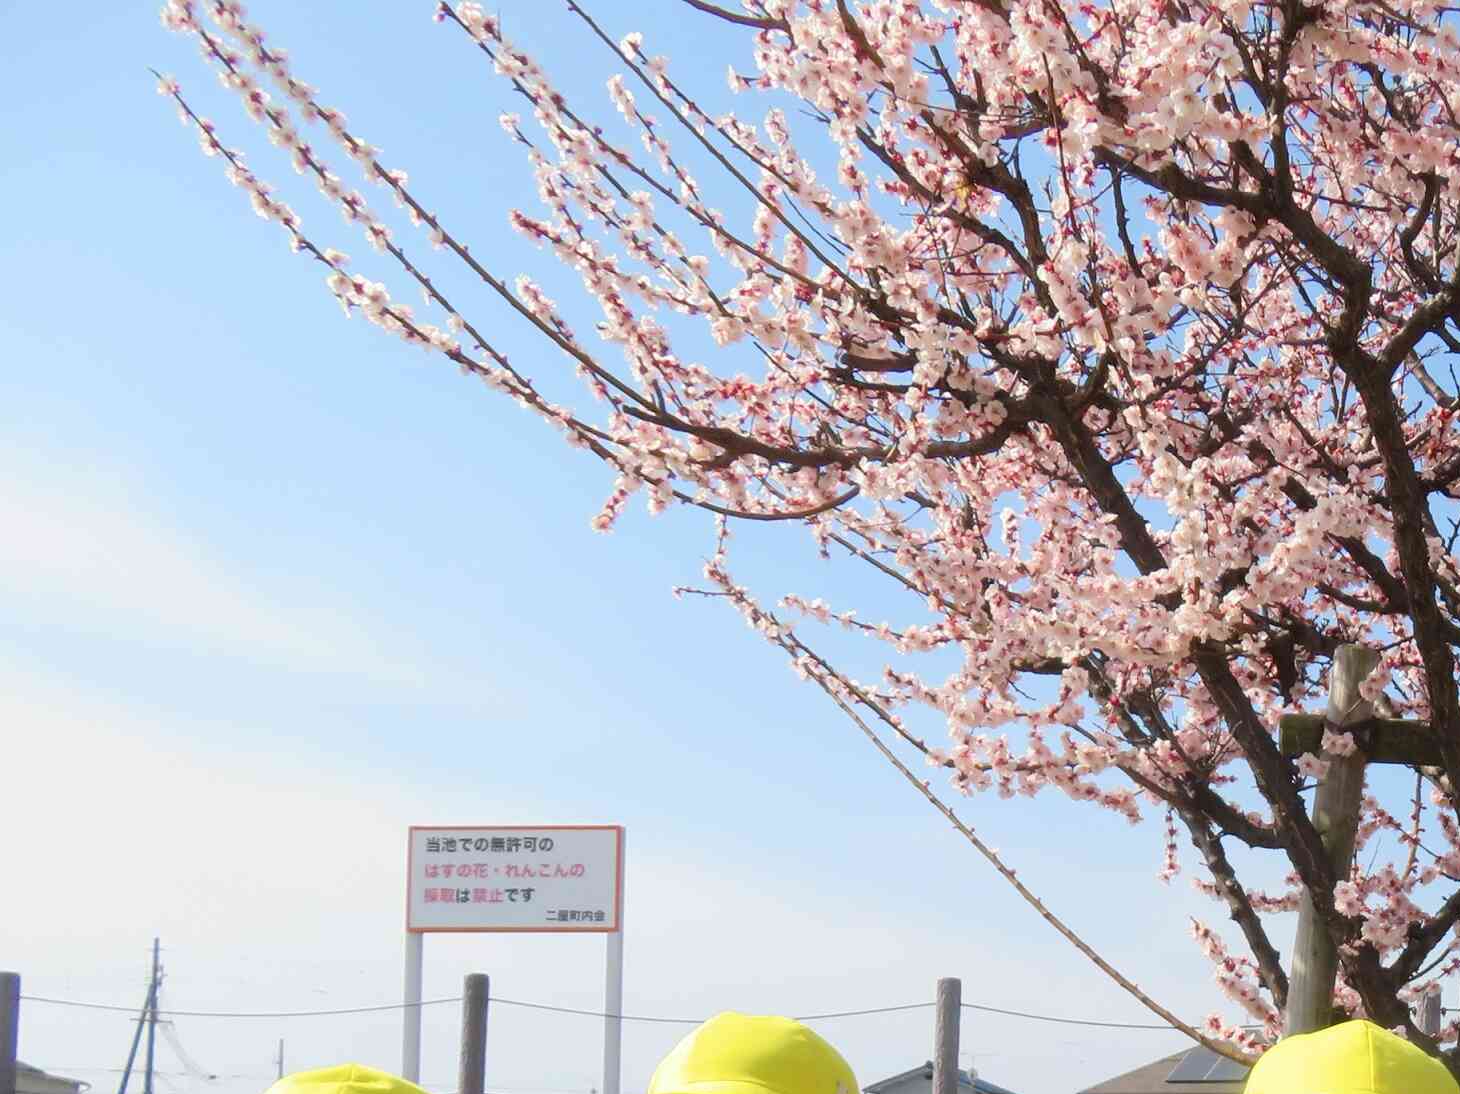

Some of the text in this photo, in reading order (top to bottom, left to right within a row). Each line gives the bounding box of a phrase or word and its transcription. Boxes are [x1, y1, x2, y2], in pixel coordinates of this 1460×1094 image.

[425, 837, 554, 853] 当池での無許可の
[424, 863, 586, 879] はすの花・れんこんの
